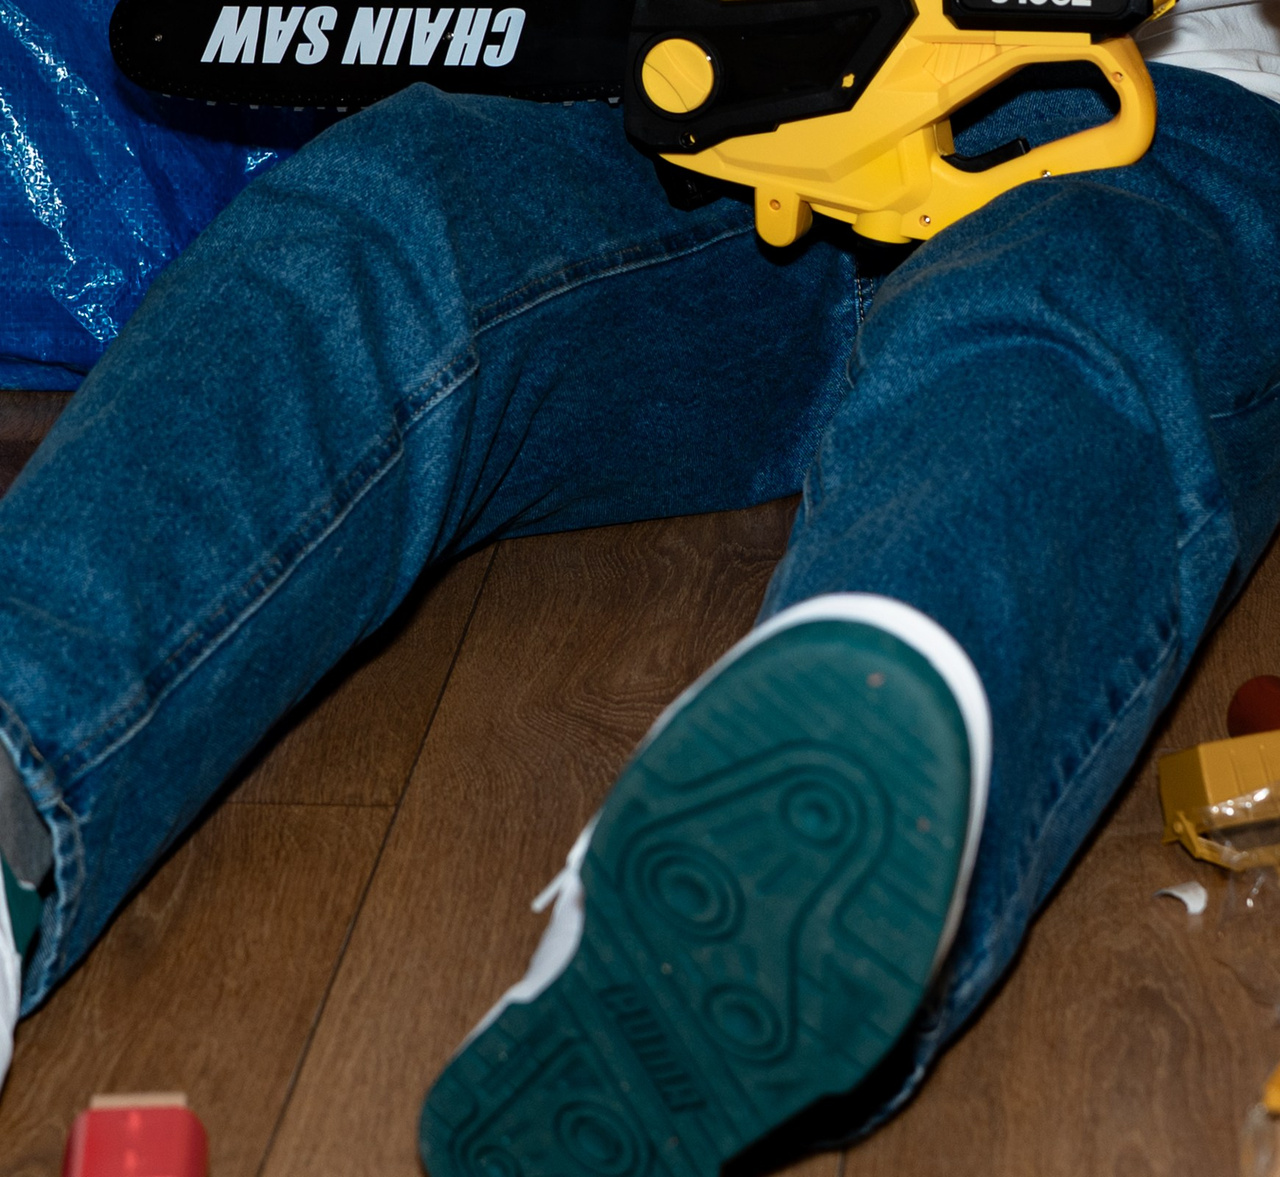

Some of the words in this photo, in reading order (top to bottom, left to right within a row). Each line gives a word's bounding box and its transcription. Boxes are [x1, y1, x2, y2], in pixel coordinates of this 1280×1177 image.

[200, 6, 338, 64] SAW
[341, 7, 526, 66] CHAIN
[599, 984, 706, 1112] PUMA
